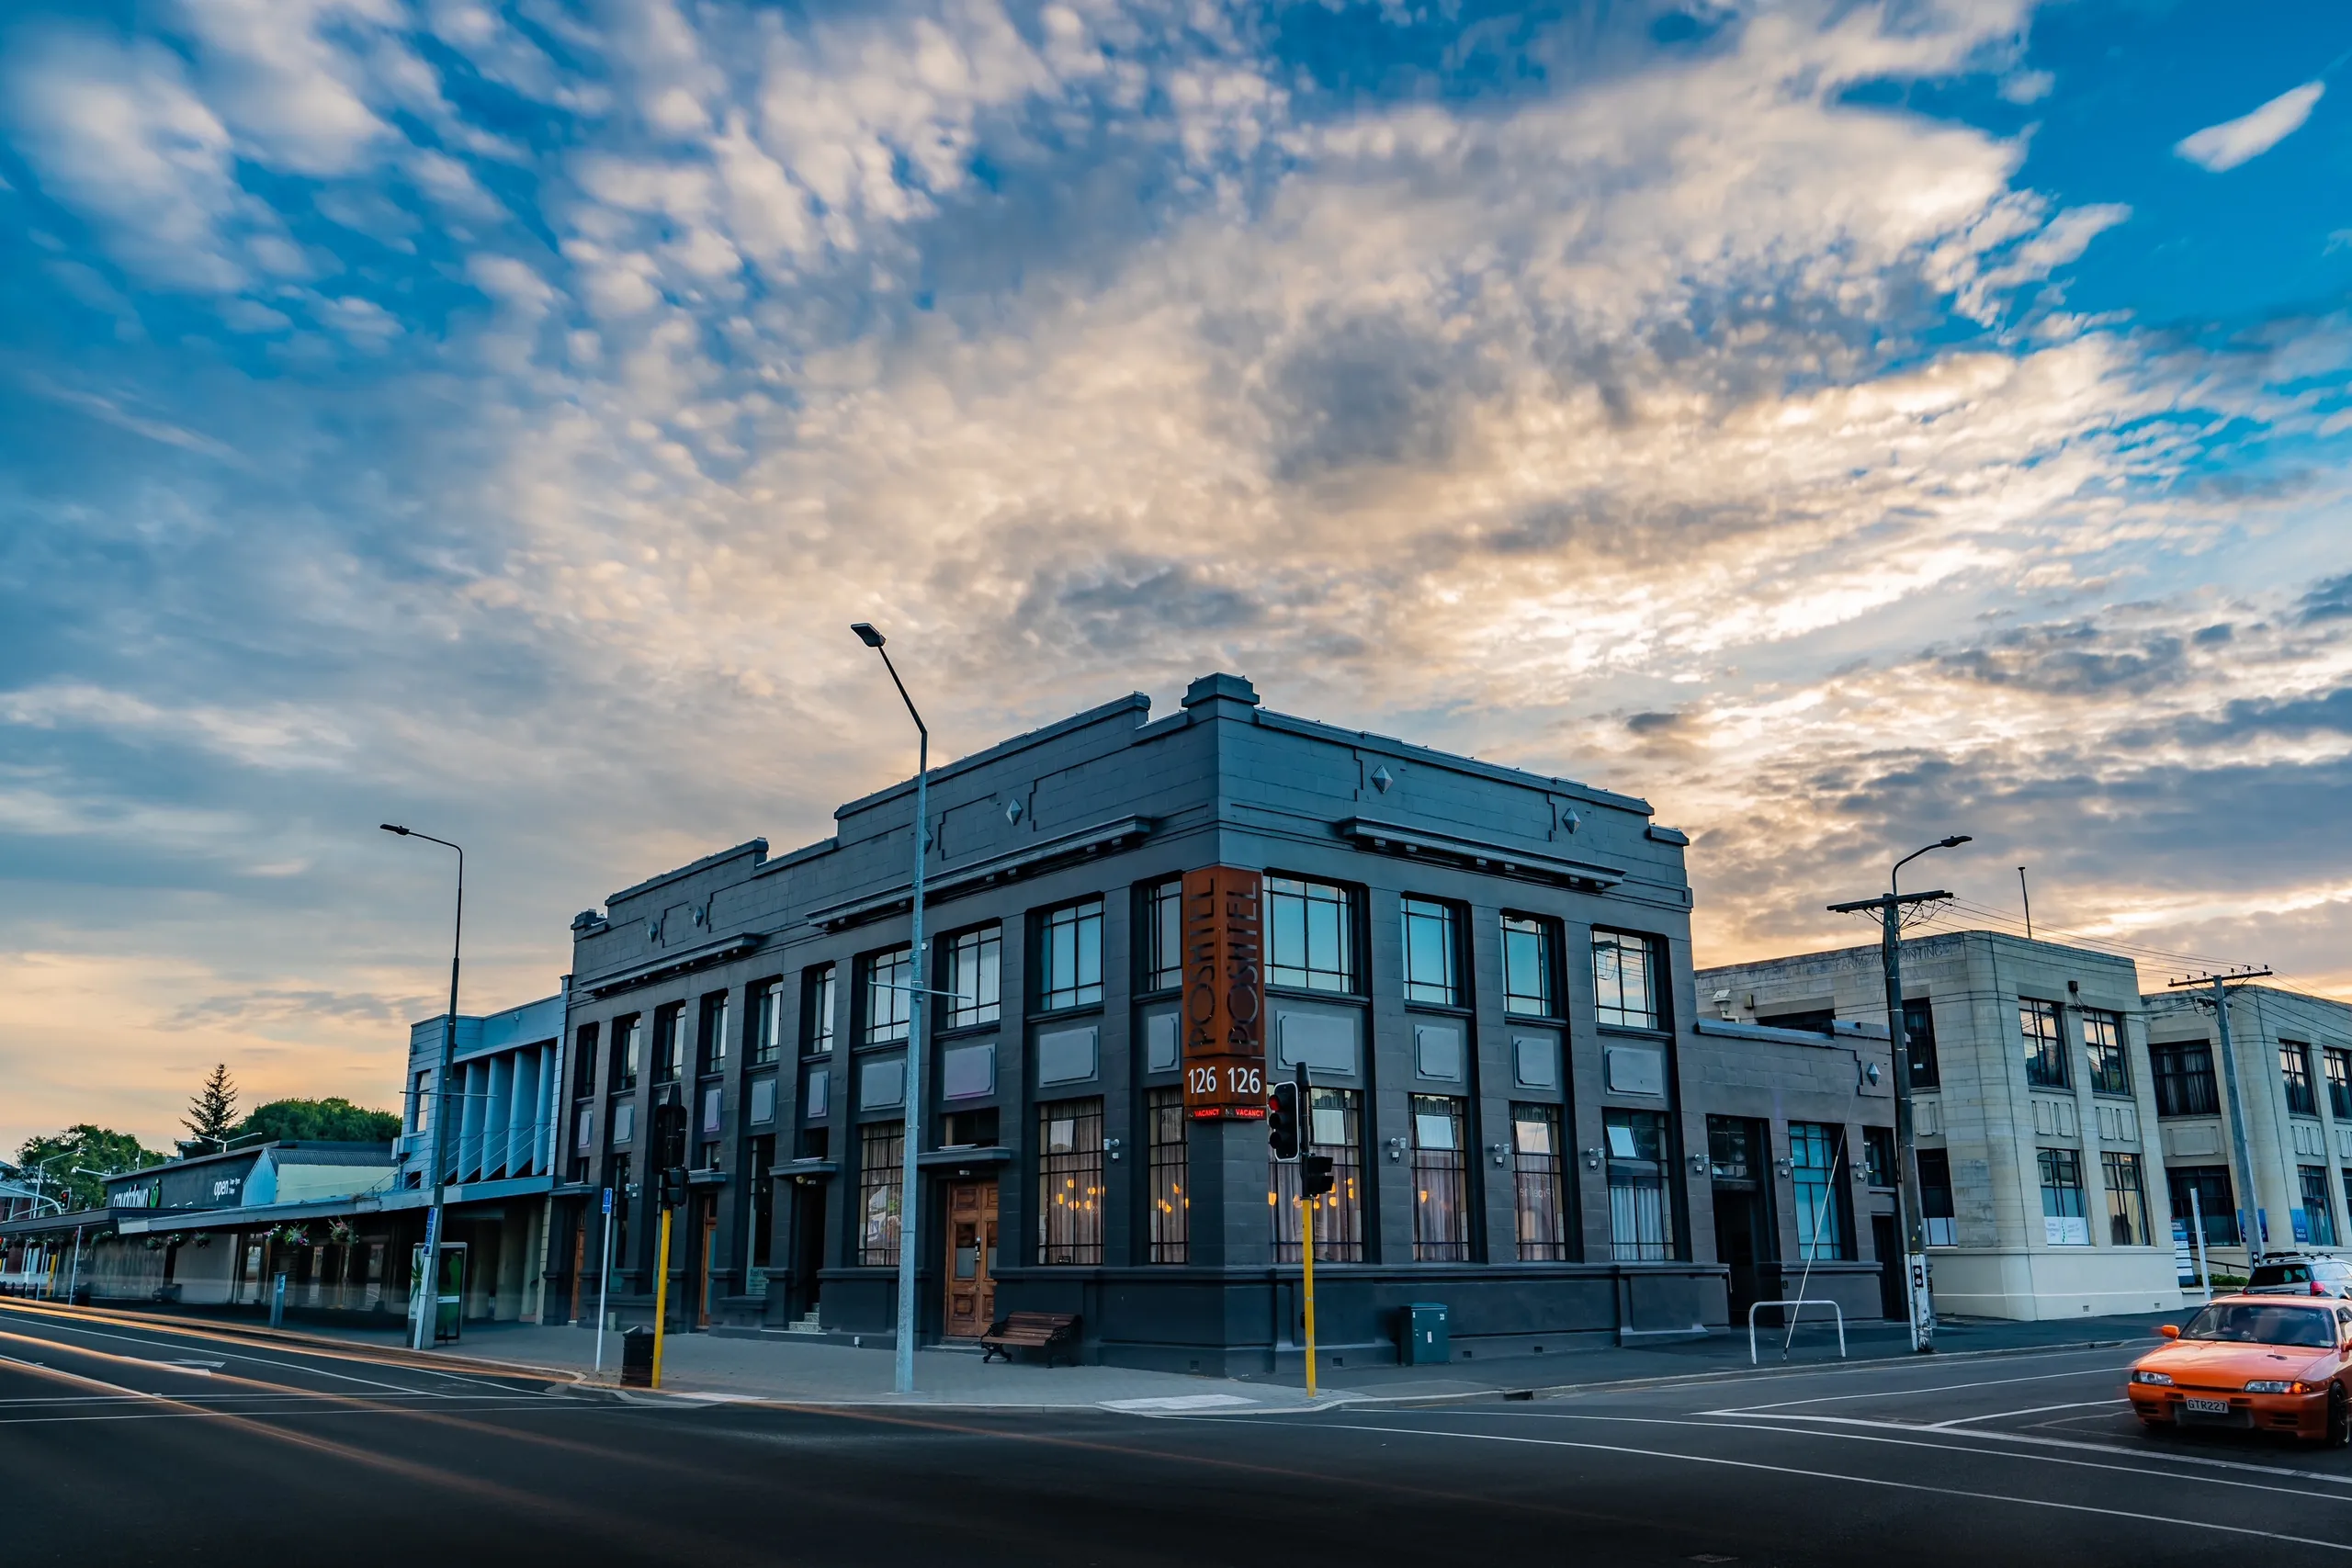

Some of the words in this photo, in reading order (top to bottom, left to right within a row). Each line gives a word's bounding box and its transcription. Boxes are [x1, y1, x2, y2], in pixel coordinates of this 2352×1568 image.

[1188, 877, 1216, 1047] POSHTEL
[1227, 881, 1259, 1046] POSHTEL
[1835, 955, 1865, 971] FARM
[1871, 945, 1943, 964] ACUNTING
[1188, 1066, 1217, 1094] 126
[1227, 1066, 1261, 1094] 126
[1194, 1108, 1220, 1118] VACANCY
[1235, 1109, 1264, 1117] VACANCY
[213, 1179, 230, 1201] open
[2188, 1399, 2226, 1412] GTR227
